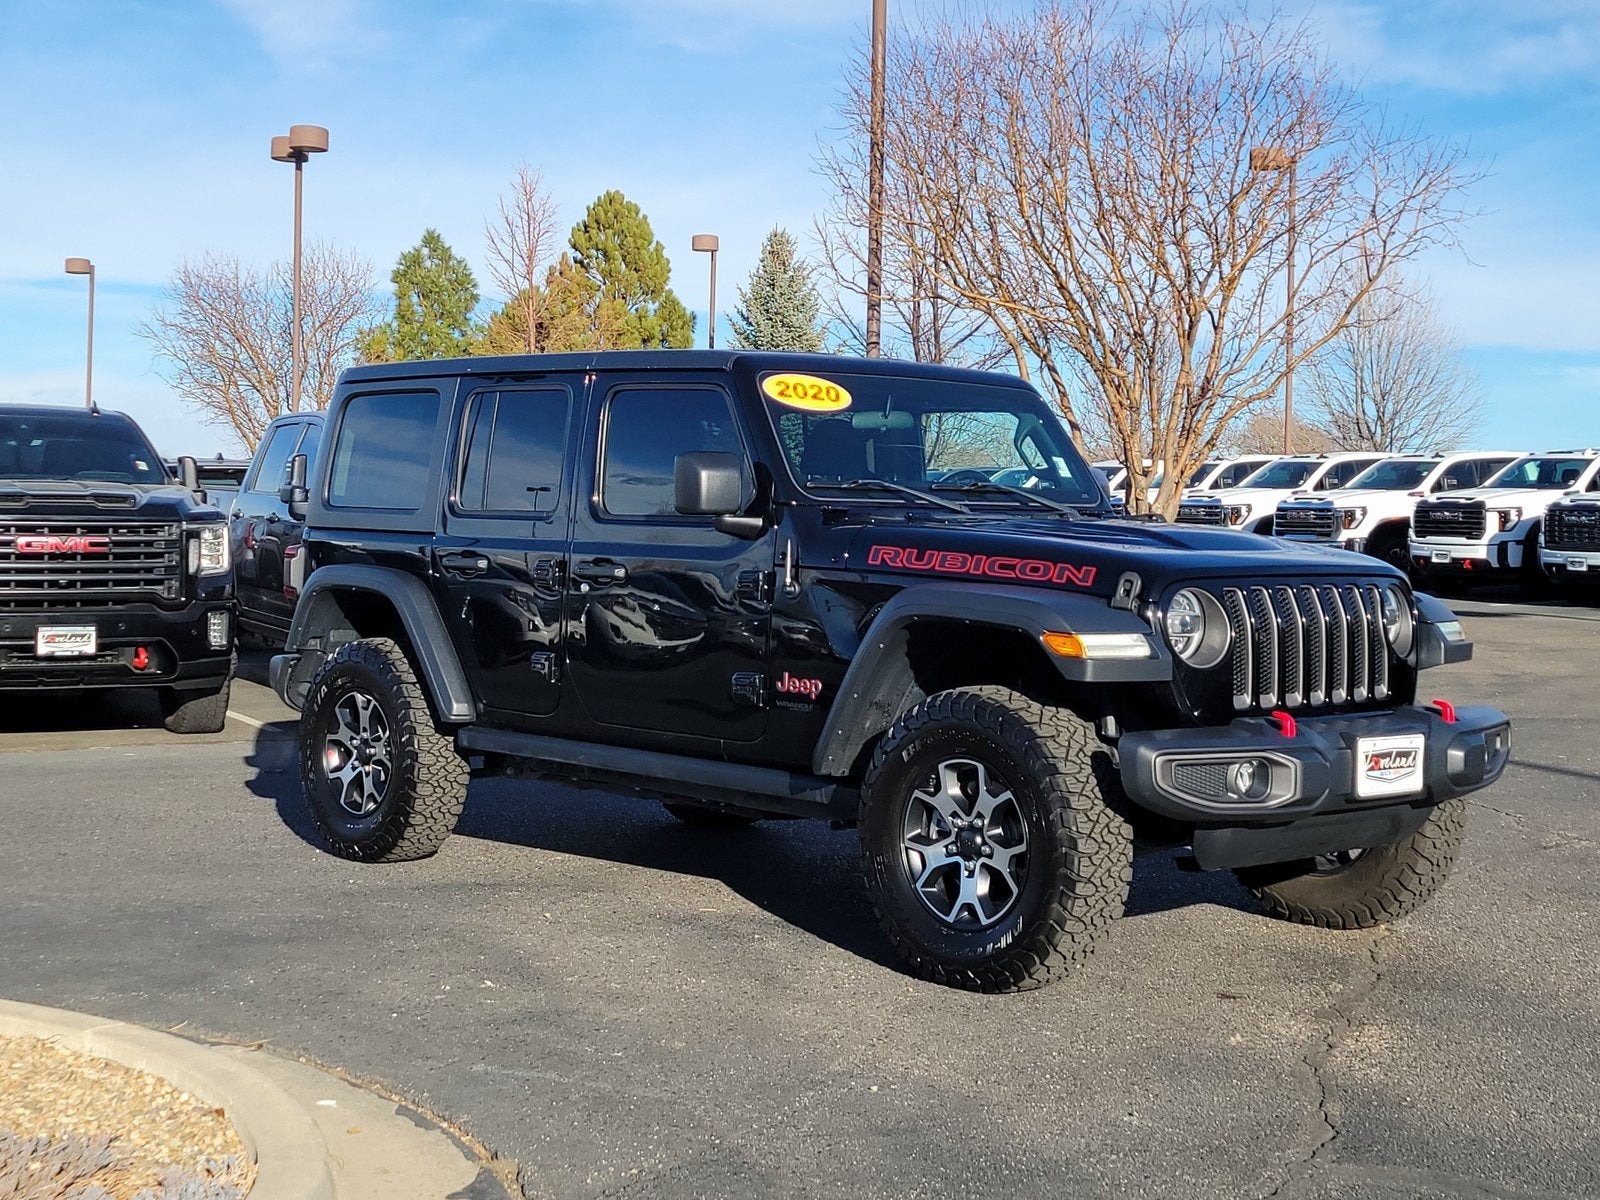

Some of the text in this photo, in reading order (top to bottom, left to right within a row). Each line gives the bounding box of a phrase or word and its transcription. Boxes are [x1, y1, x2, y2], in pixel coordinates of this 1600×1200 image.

[776, 381, 840, 402] 2020
[16, 536, 109, 553] GMC
[867, 545, 1097, 587] RUBICON
[776, 671, 822, 699] Jeep
